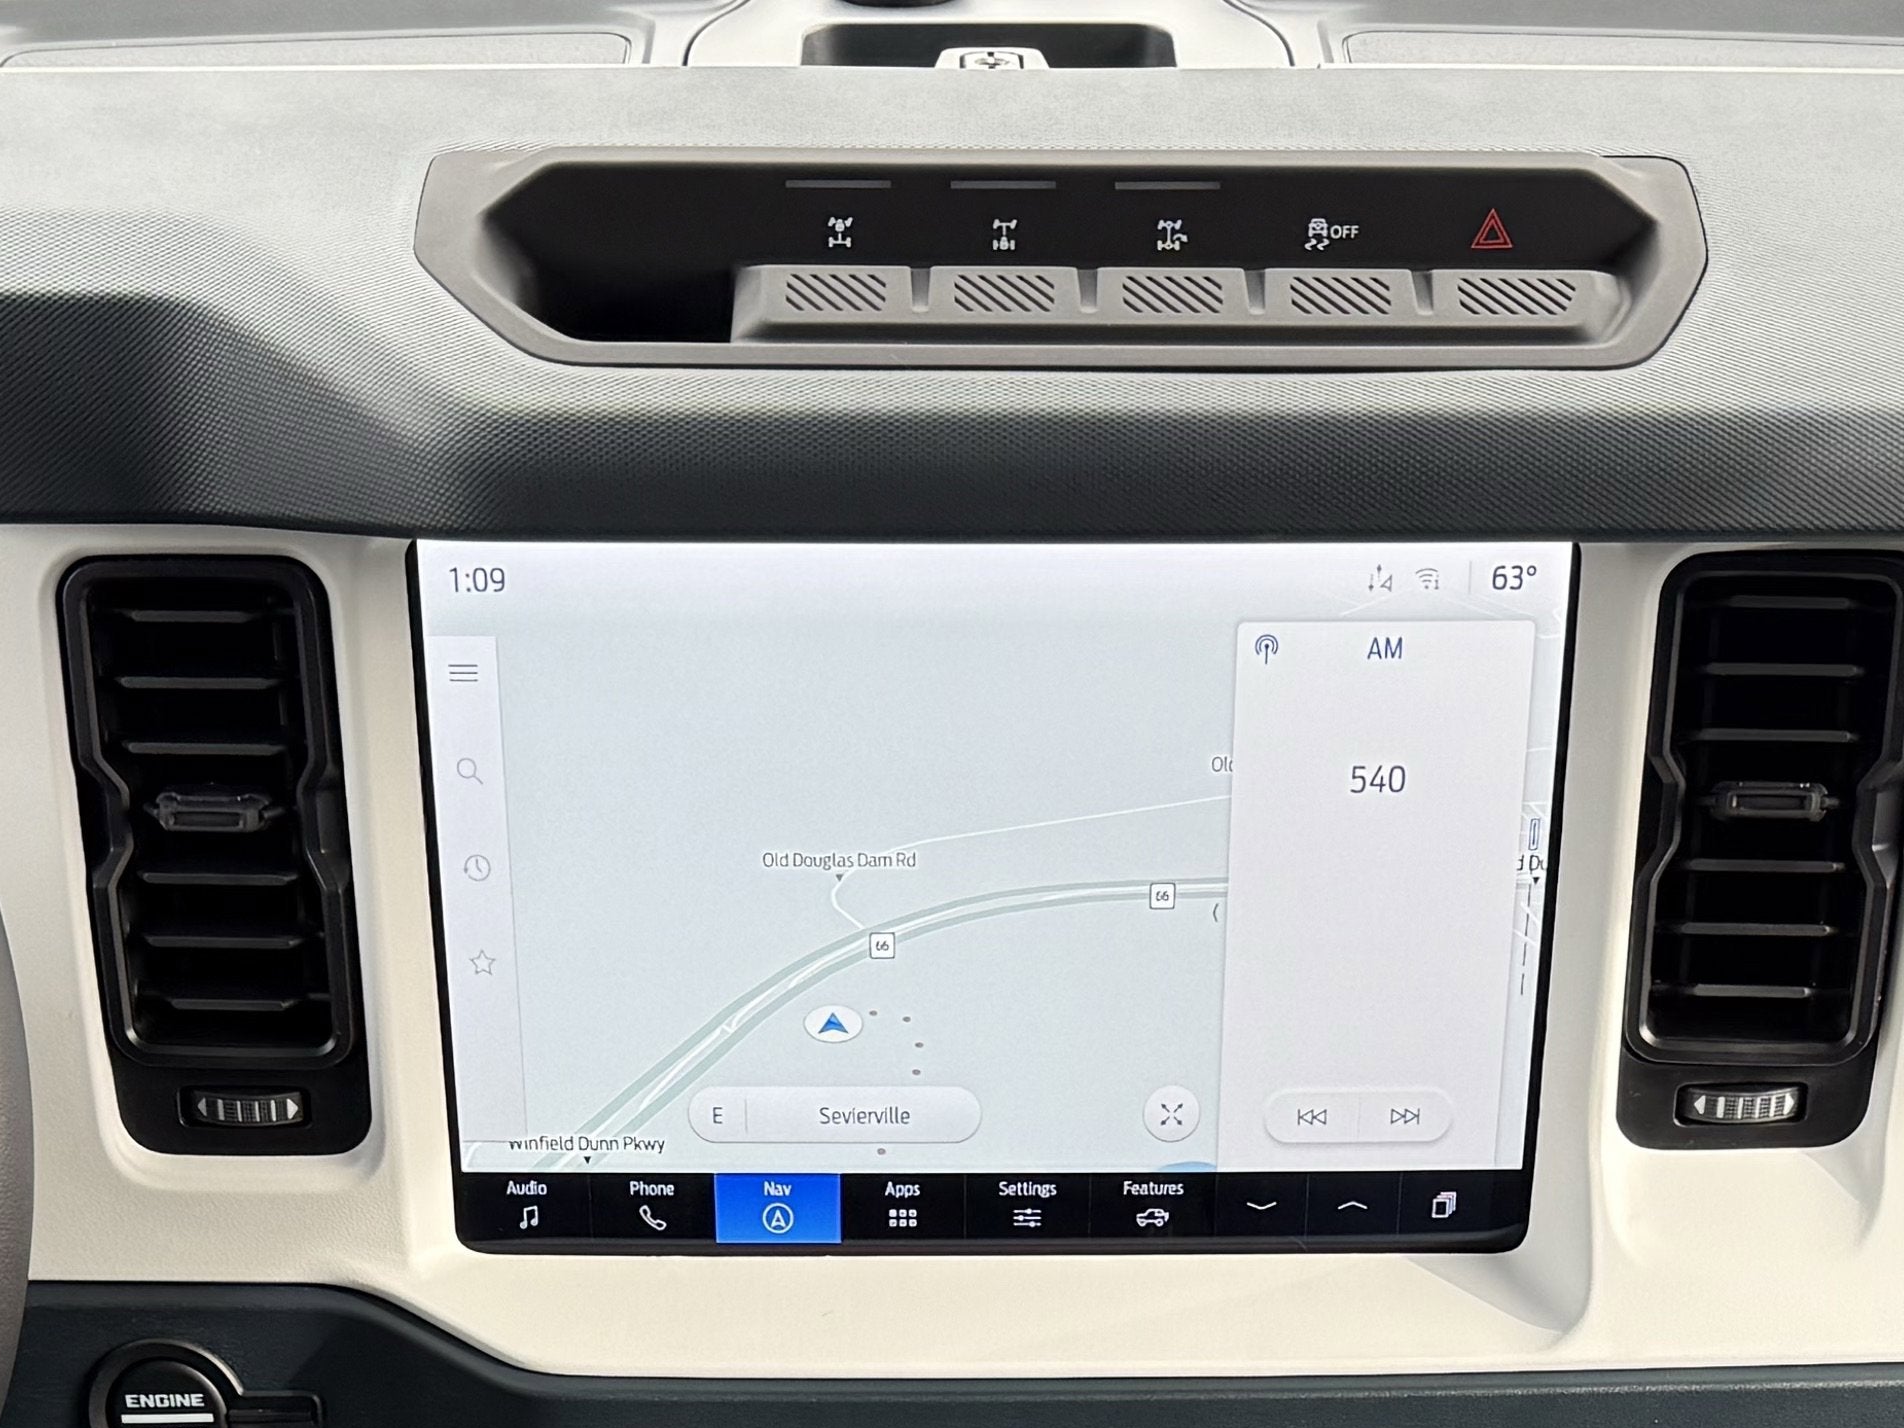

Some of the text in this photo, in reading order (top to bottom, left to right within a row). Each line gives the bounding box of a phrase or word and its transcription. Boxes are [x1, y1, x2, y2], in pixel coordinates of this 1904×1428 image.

[1330, 225, 1360, 239] OFF
[449, 567, 506, 593] 1:09
[1491, 564, 1538, 591] 63°
[1367, 636, 1404, 660] AM
[1350, 764, 1407, 794] 540
[762, 852, 917, 870] Old Douglas Dam Rd
[712, 1107, 723, 1124] E
[818, 1106, 912, 1126] Sevierville
[578, 1136, 620, 1151] Dunn
[622, 1136, 666, 1155] Pkwy
[506, 1180, 548, 1196] Audio
[629, 1181, 676, 1197] Phone
[763, 1181, 793, 1196] Nav
[884, 1182, 922, 1200] Apps
[998, 1181, 1058, 1198] Settings
[1123, 1180, 1185, 1196] Features
[124, 1394, 205, 1409] ENGINE
